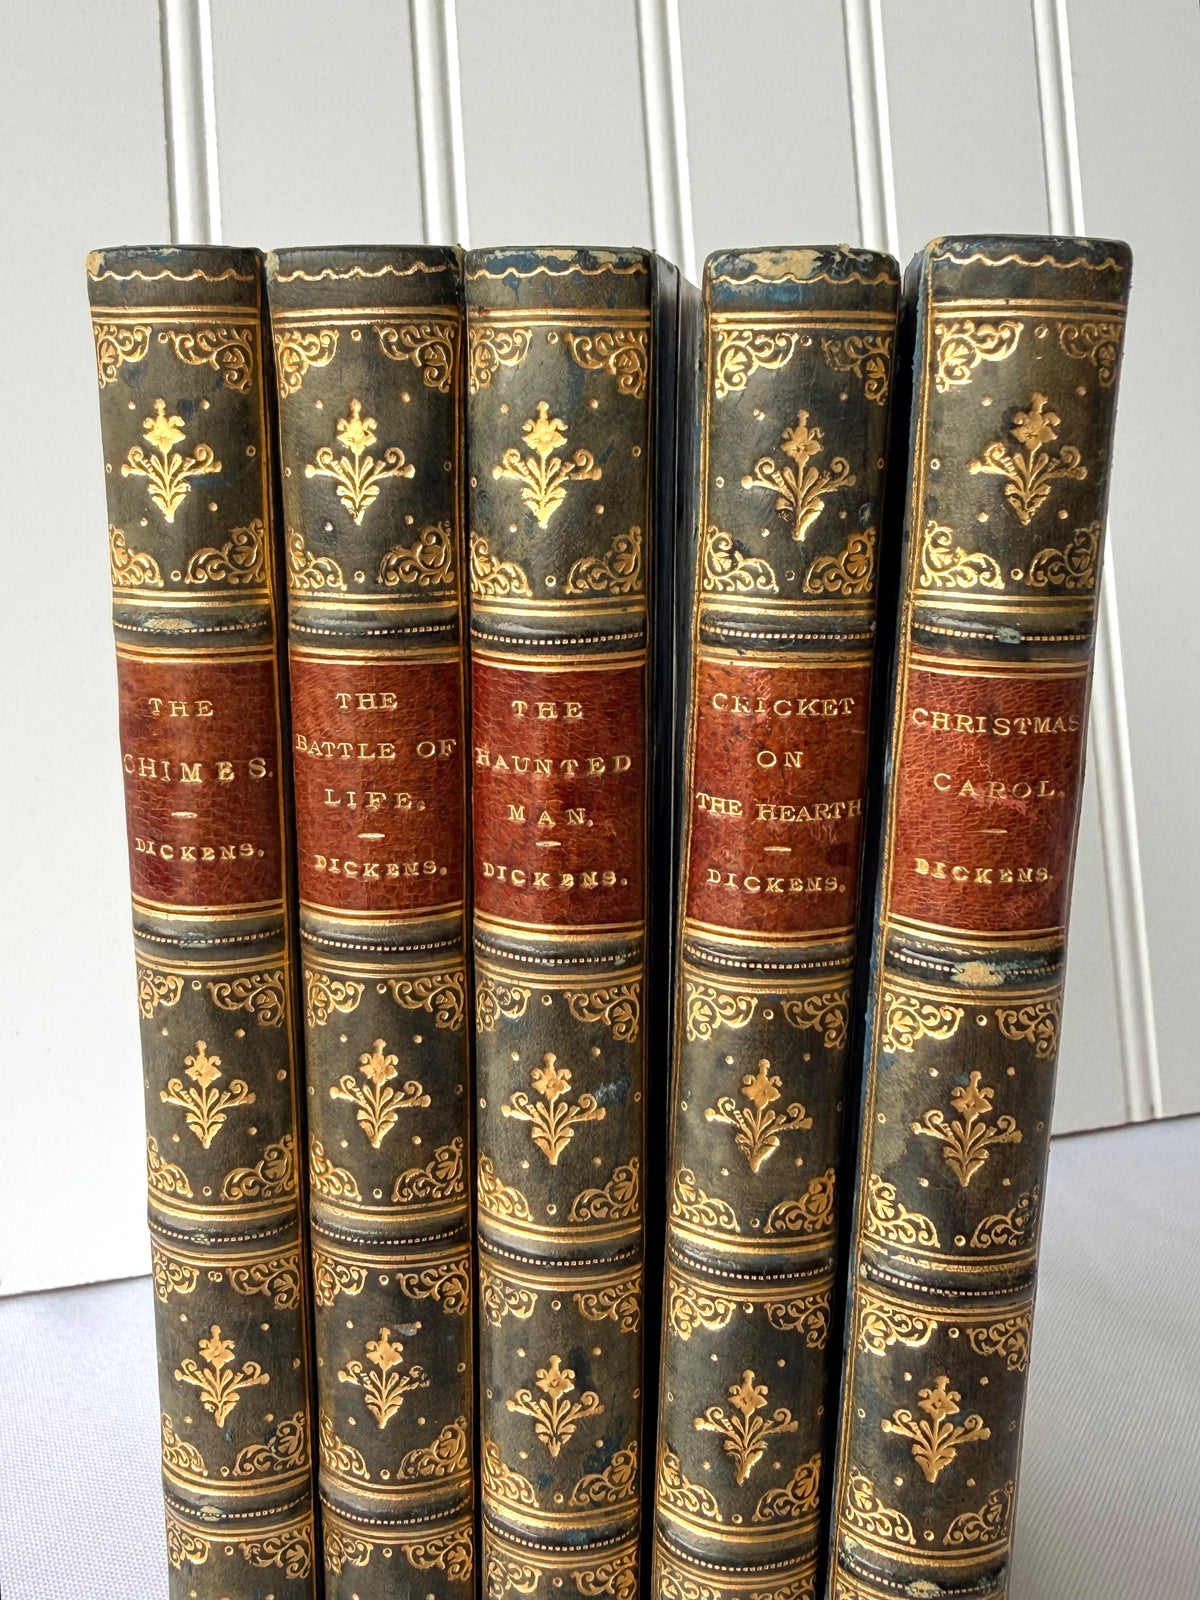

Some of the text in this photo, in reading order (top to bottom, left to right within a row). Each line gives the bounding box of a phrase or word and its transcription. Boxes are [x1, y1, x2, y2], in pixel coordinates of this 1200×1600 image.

[148, 697, 215, 718] THE
[335, 692, 398, 711] THE
[511, 700, 583, 720] THE
[712, 692, 855, 717] CRICKET
[912, 707, 1081, 736] CHRISTMAS
[295, 733, 458, 760] BATTLE OF
[123, 753, 274, 783] CHIMES.
[475, 747, 632, 775] HAUNTED
[756, 750, 804, 769] ON
[933, 773, 1067, 800] CAROL.
[324, 788, 426, 811] LIFE.
[695, 792, 863, 823] THE HEARTH
[507, 804, 594, 826] MAN.
[135, 837, 265, 862] DICKENS.
[314, 854, 448, 879] DICKENS.
[483, 862, 628, 888] DICKENS.
[706, 868, 846, 894] DICKENS.
